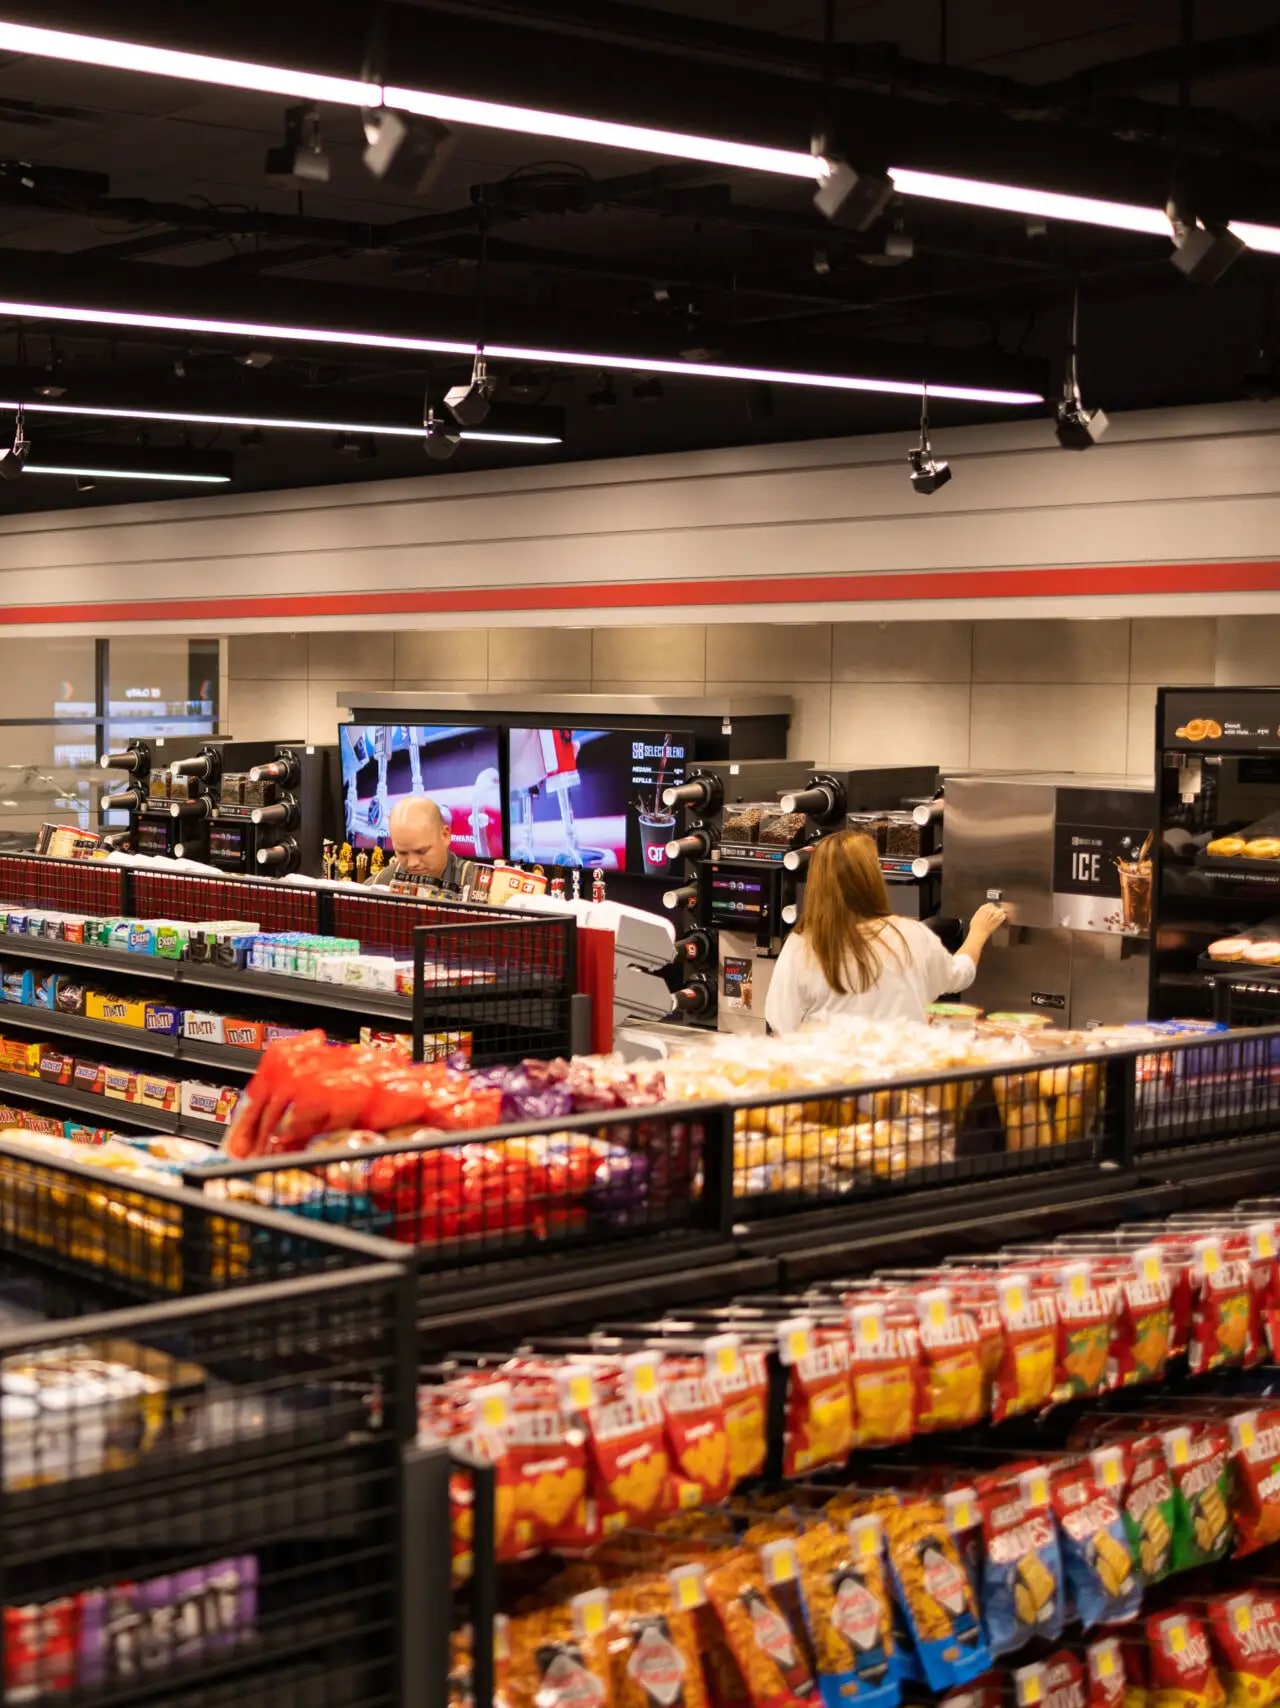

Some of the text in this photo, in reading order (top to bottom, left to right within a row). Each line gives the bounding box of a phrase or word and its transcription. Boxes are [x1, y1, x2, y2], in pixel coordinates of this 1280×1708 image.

[644, 745, 664, 758] SELECT
[648, 847, 664, 862] QT
[1072, 852, 1100, 881] ICE
